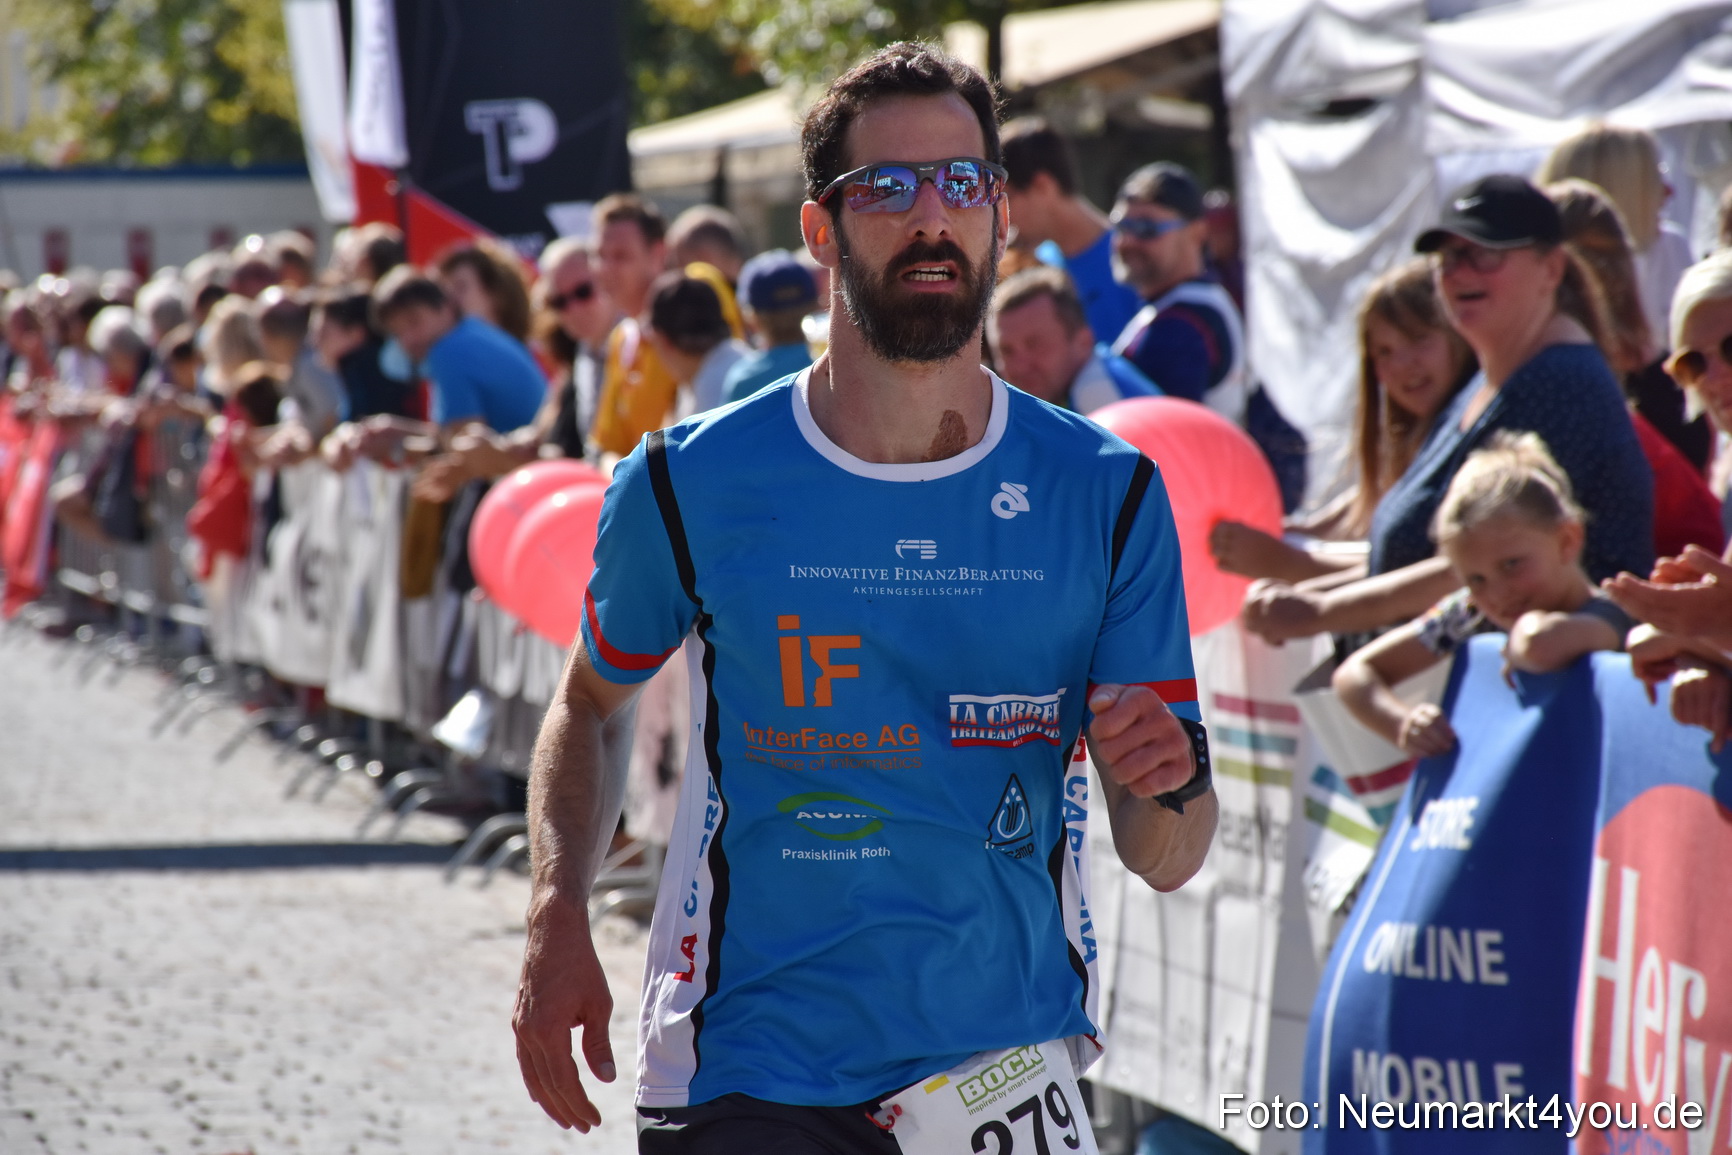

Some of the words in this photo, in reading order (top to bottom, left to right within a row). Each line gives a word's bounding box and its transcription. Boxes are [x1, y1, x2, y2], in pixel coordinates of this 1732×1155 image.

[853, 586, 984, 596] AKTIENGESELLSCHAFT
[949, 704, 978, 726] LA
[743, 721, 869, 749] InterFace
[878, 723, 921, 747] AG
[744, 751, 766, 764] the
[809, 756, 825, 771] of
[830, 754, 922, 770] informatics
[782, 848, 857, 860] Praxisklinik
[861, 847, 891, 859] Roth
[673, 933, 698, 983] LA
[1363, 920, 1508, 986] ONLINE
[955, 1045, 1044, 1107] BOCK
[968, 1093, 998, 1116] inspired
[997, 1088, 1008, 1099] by
[1007, 1076, 1028, 1093] smart
[970, 1081, 1081, 1155] 279
